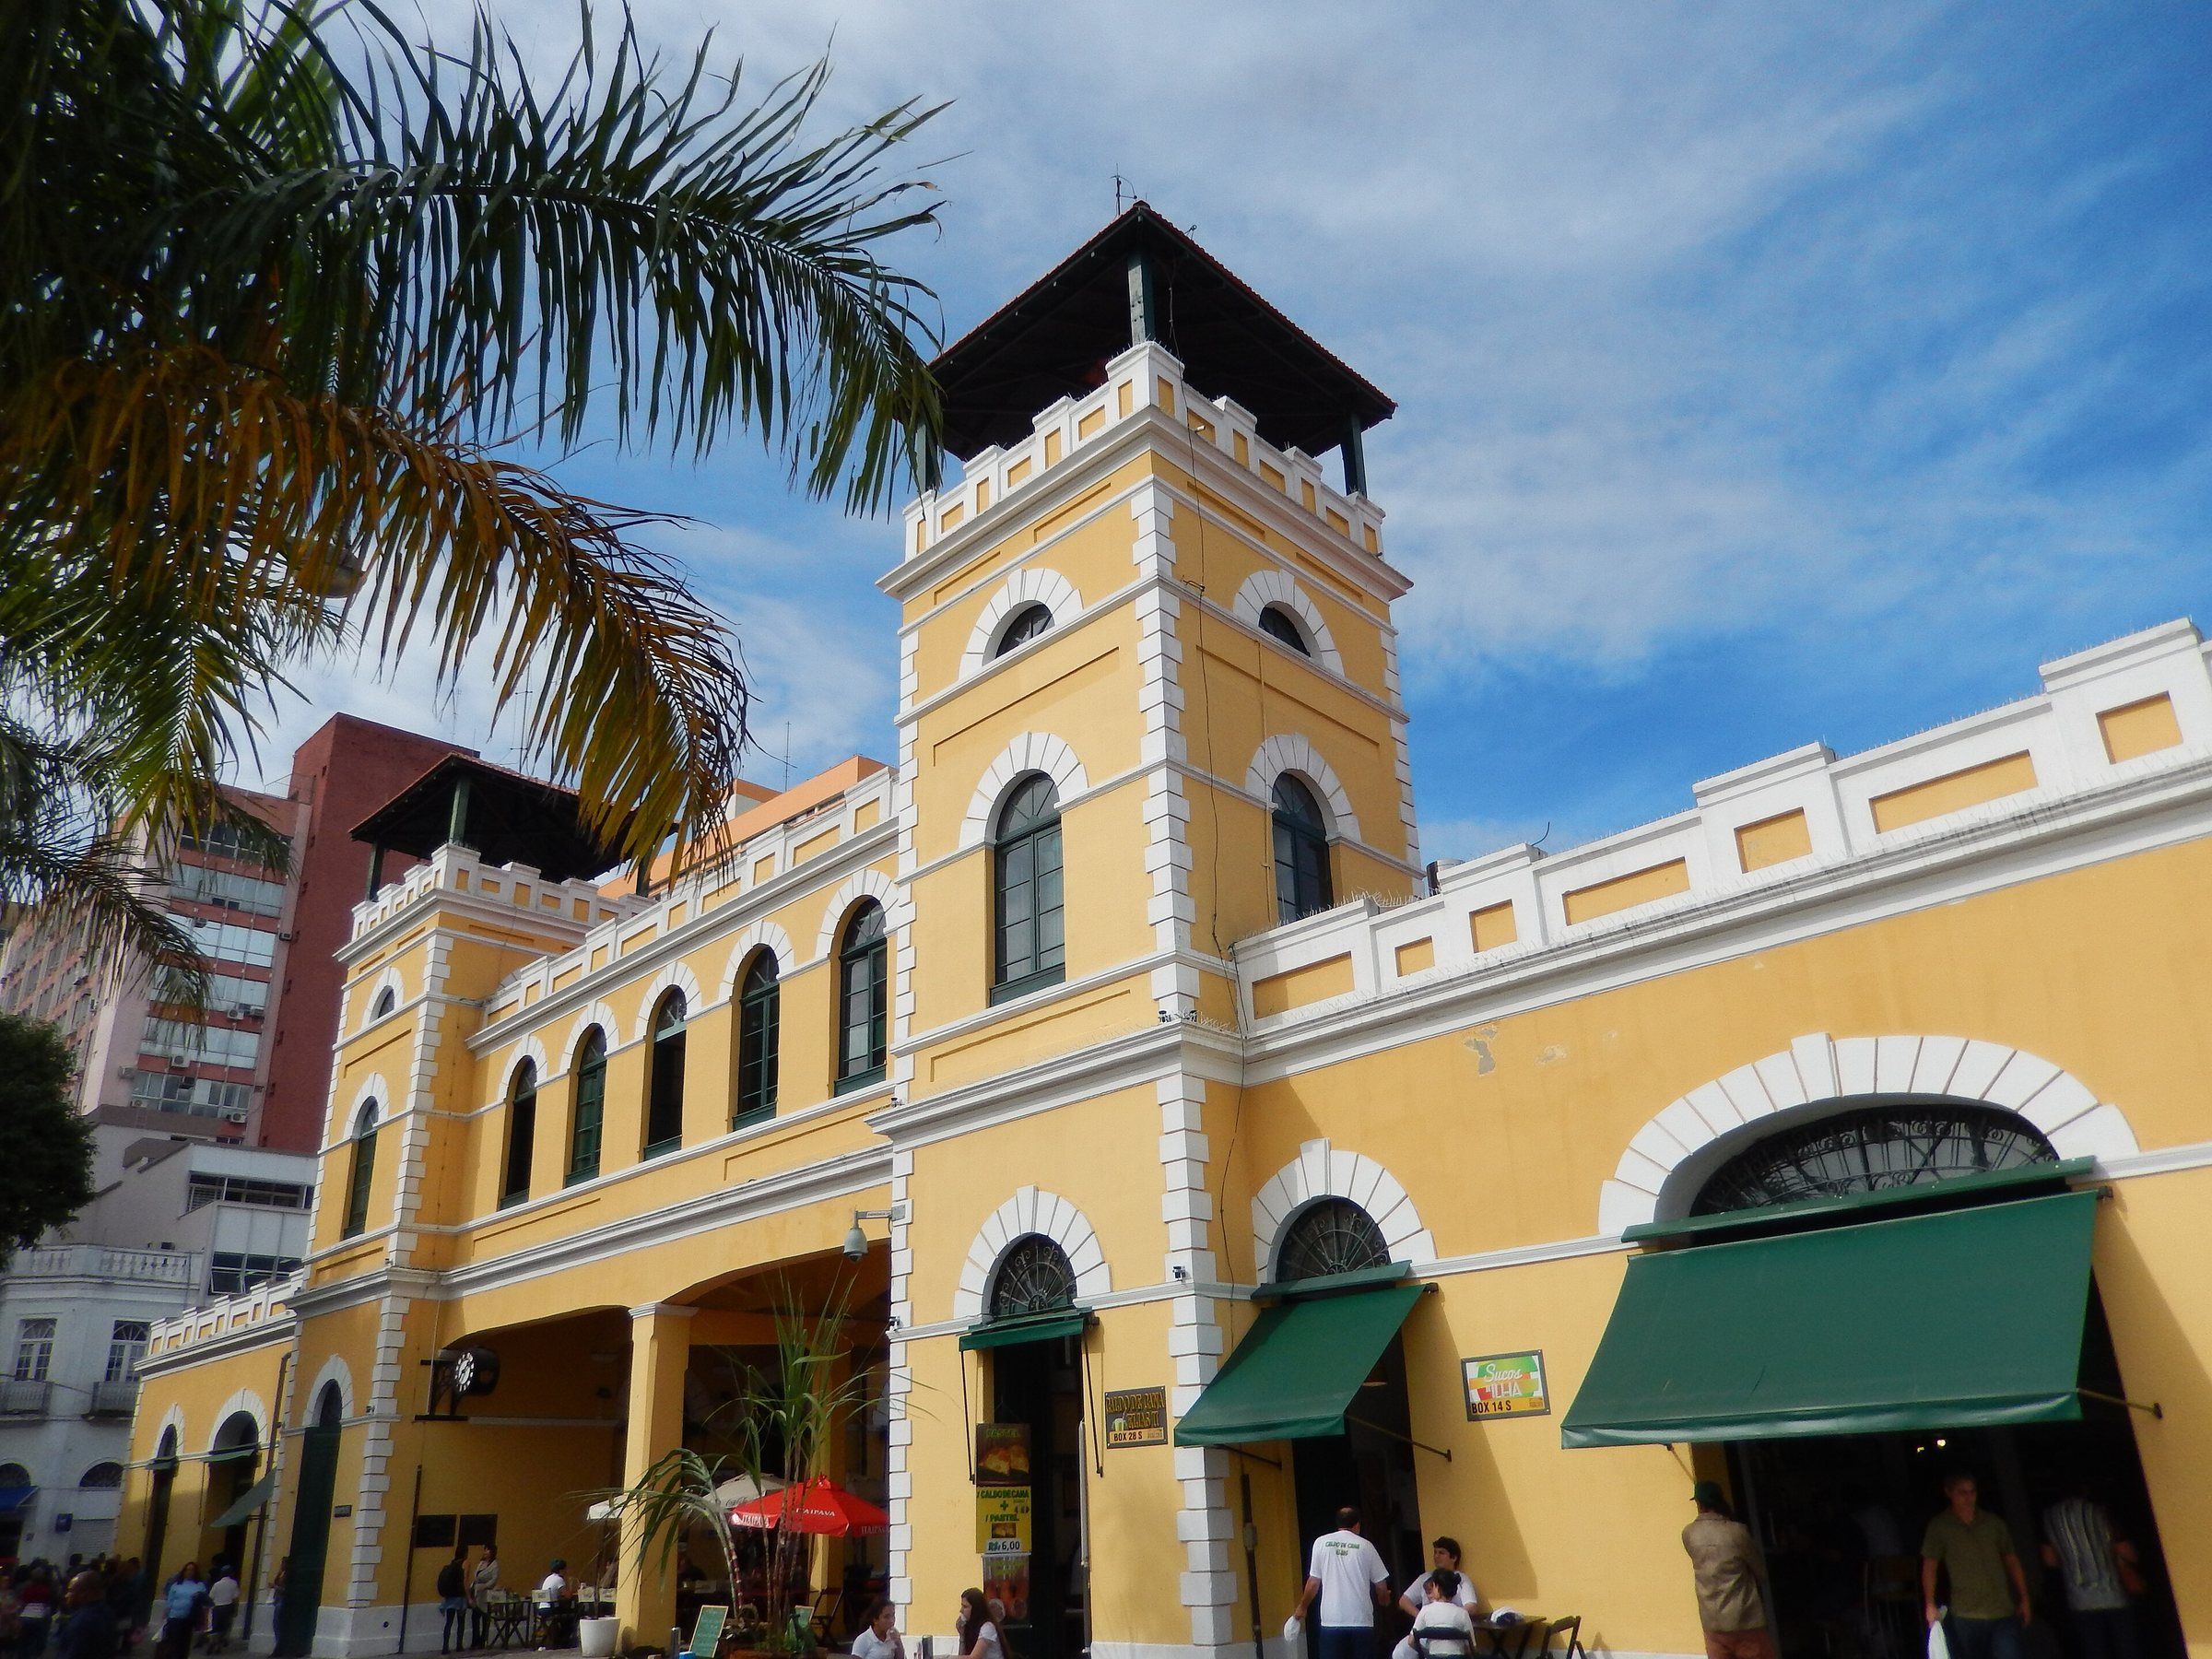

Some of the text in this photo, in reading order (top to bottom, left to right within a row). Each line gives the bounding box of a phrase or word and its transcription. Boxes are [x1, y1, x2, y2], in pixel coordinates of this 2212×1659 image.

[1484, 1363, 1523, 1382] Sucos
[1472, 1399, 1512, 1414] BOX 14 S
[1113, 1432, 1127, 1442] BOX
[1128, 1431, 1137, 1441] 28
[1137, 1430, 1143, 1440] S
[1002, 1541, 1020, 1551] 6,00
